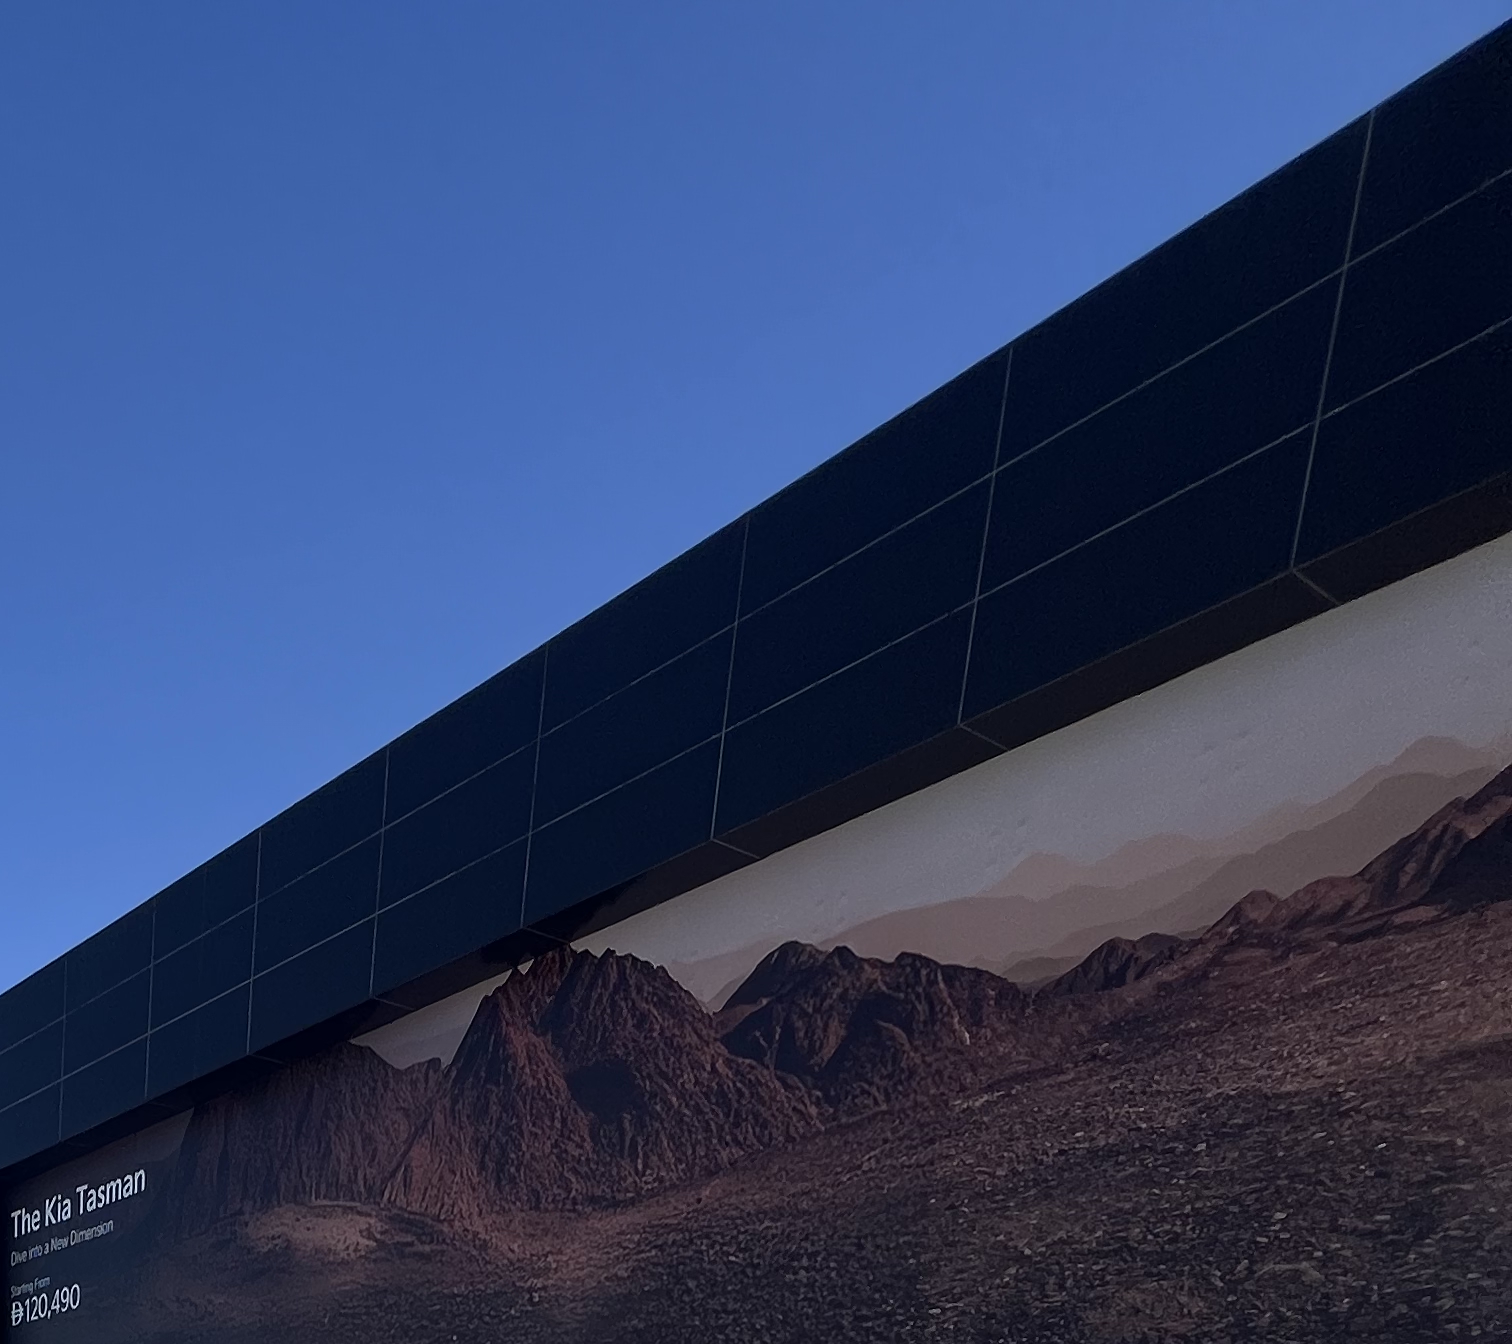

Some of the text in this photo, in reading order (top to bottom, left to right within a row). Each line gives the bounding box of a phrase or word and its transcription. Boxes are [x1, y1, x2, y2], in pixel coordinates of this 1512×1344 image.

[10, 1168, 146, 1239] The Kia Tasman
[10, 1219, 114, 1267] Dive into a New Dimension
